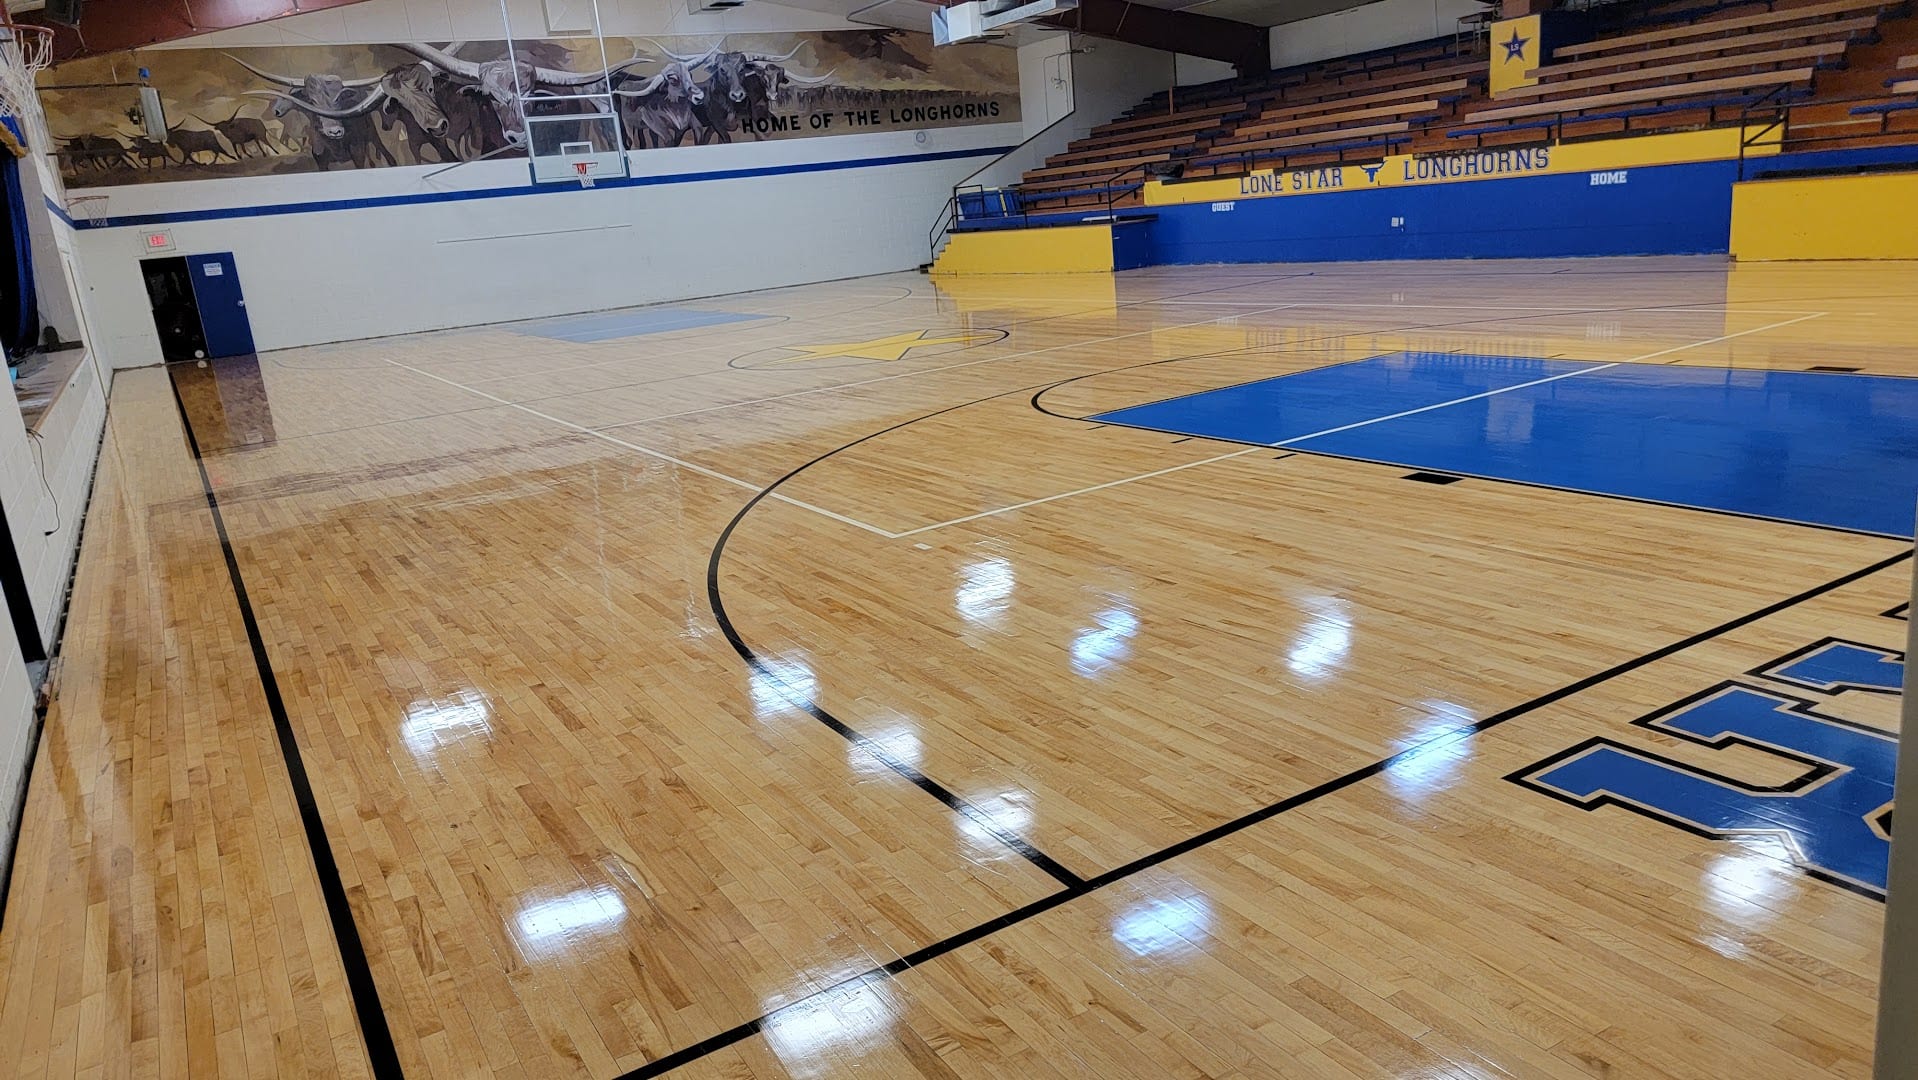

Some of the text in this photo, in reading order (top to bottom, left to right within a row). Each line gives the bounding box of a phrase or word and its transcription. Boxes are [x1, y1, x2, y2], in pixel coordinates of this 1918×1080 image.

[742, 101, 1000, 133] HOME OF THE LONGHORNS
[1240, 147, 1550, 195] LONE STAR LONGHORNS
[1590, 171, 1628, 186] HOME
